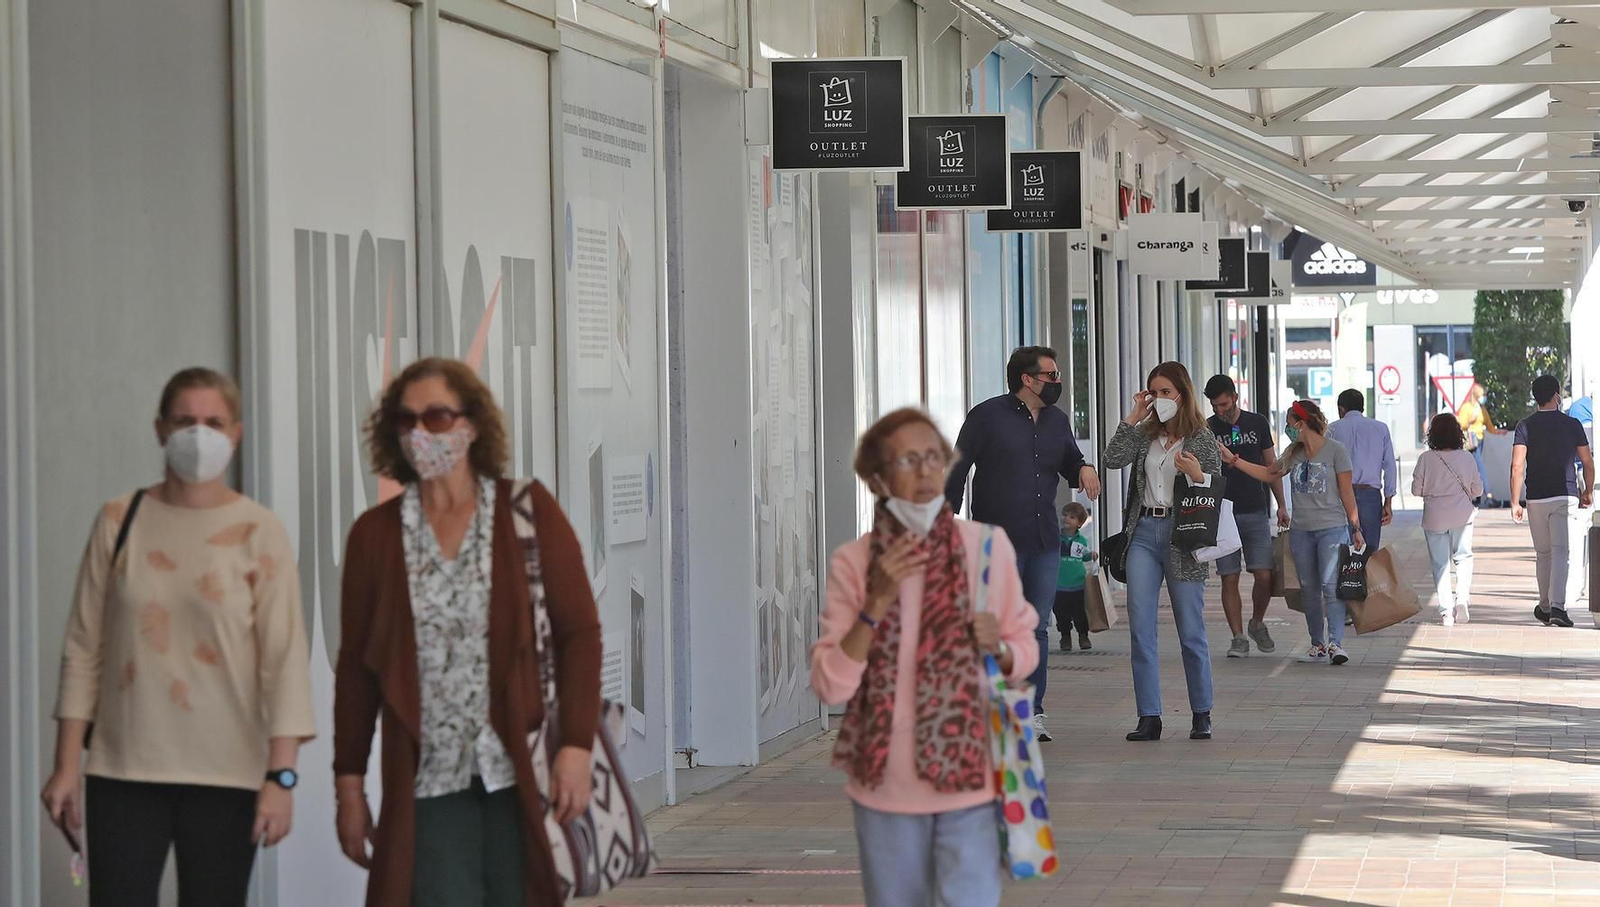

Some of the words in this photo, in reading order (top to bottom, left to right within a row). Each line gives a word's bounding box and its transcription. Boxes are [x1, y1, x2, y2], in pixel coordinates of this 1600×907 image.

[824, 109, 852, 121] LUZ
[809, 141, 868, 151] OUTLET
[940, 157, 964, 167] LUZ
[928, 184, 976, 192] OUTLET
[1023, 187, 1045, 196] LUZ
[1013, 210, 1056, 218] OUTLET
[1137, 241, 1194, 252] Charanga
[1303, 259, 1367, 275] adidas
[1313, 371, 1332, 395] P
[1216, 430, 1258, 447] ADDAS
